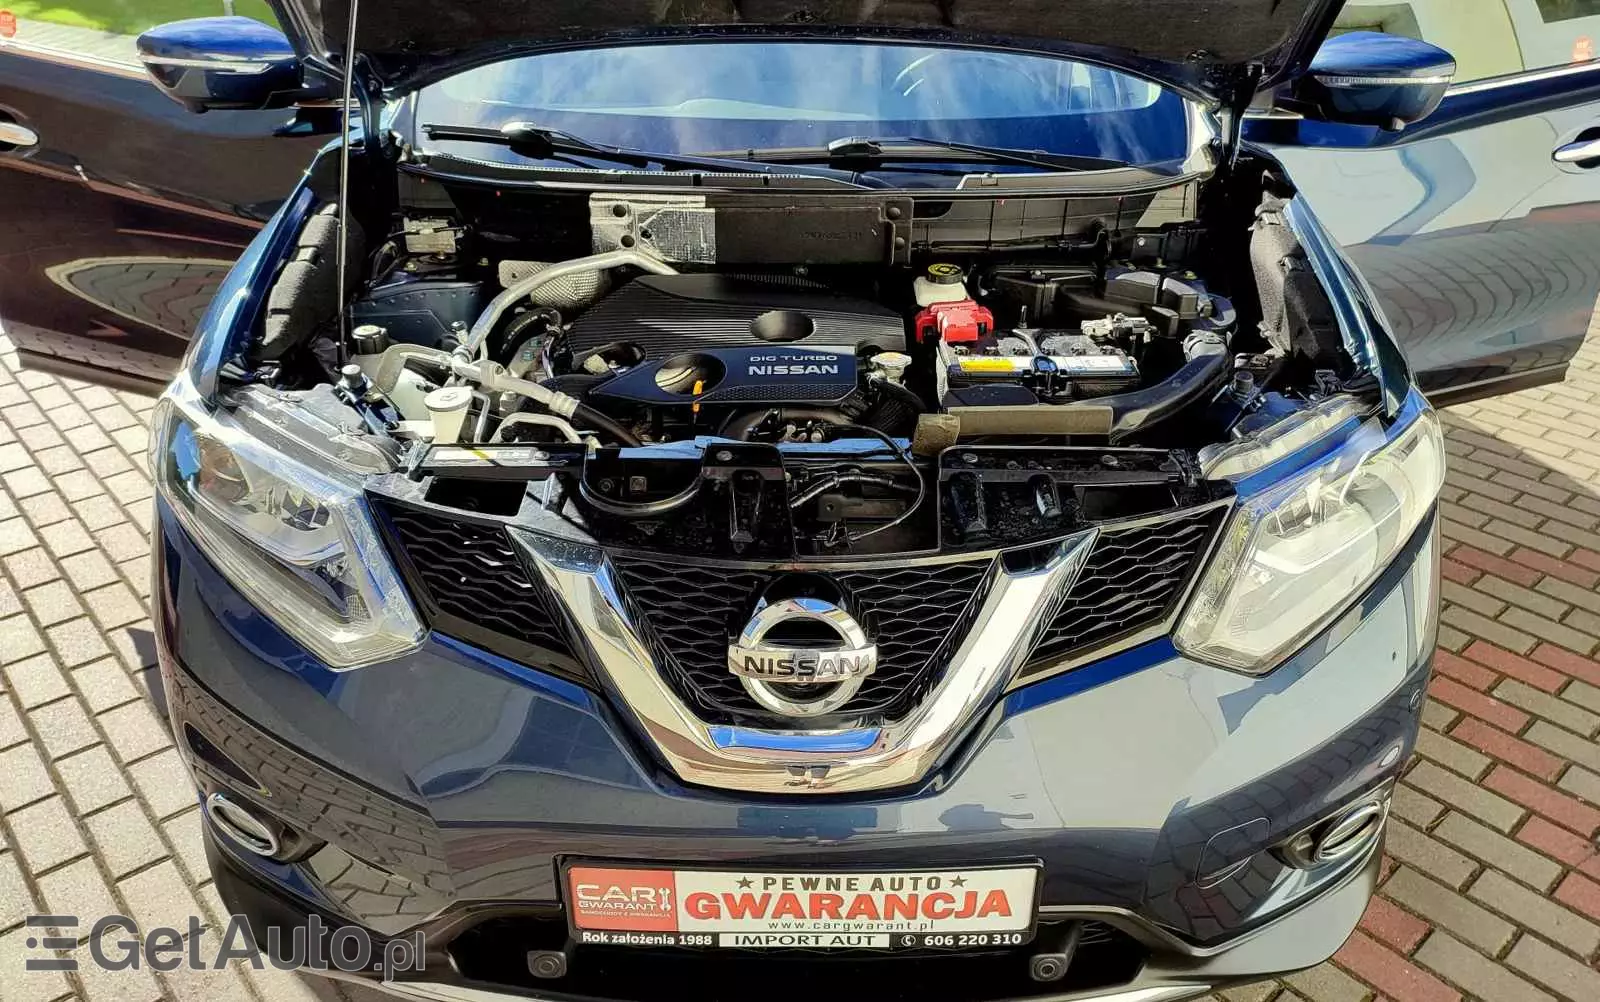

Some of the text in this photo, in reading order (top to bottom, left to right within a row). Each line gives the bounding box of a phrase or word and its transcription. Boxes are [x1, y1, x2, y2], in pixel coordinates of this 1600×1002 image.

[748, 365, 838, 375] NISSAN
[744, 655, 860, 677] NISSAN
[763, 876, 941, 891] PEWNE AUTO
[576, 884, 657, 903] CAR
[578, 900, 657, 911] GWARANT
[684, 889, 1012, 921] GWARANCJA
[768, 920, 934, 931] www.cargwarant.pl
[582, 932, 712, 945] Rok założenia 1988
[735, 935, 876, 946] IMPORT AUT
[924, 933, 1022, 946] 606 220 310
